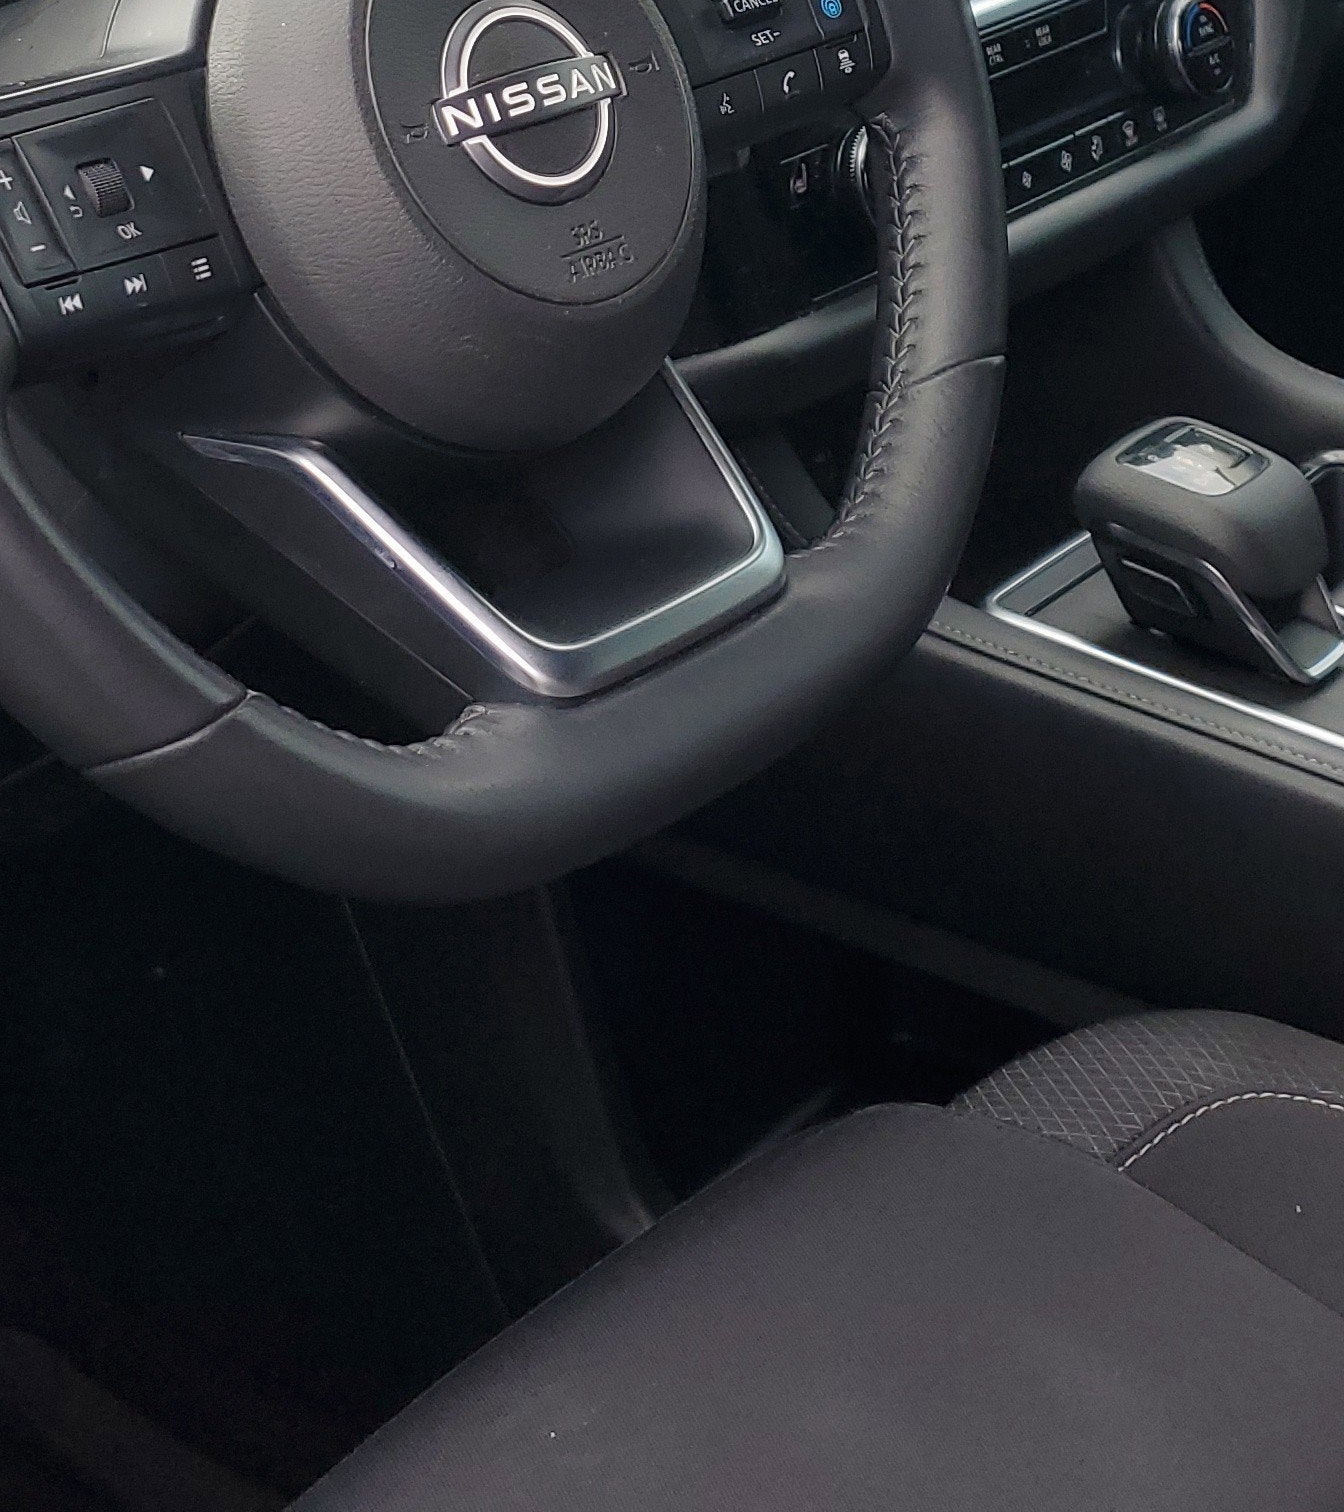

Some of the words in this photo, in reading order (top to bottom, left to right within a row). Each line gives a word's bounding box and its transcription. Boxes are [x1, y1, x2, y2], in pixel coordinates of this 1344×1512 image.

[750, 29, 782, 48] SET-
[440, 61, 617, 137] NISSAN
[117, 221, 143, 240] OK
